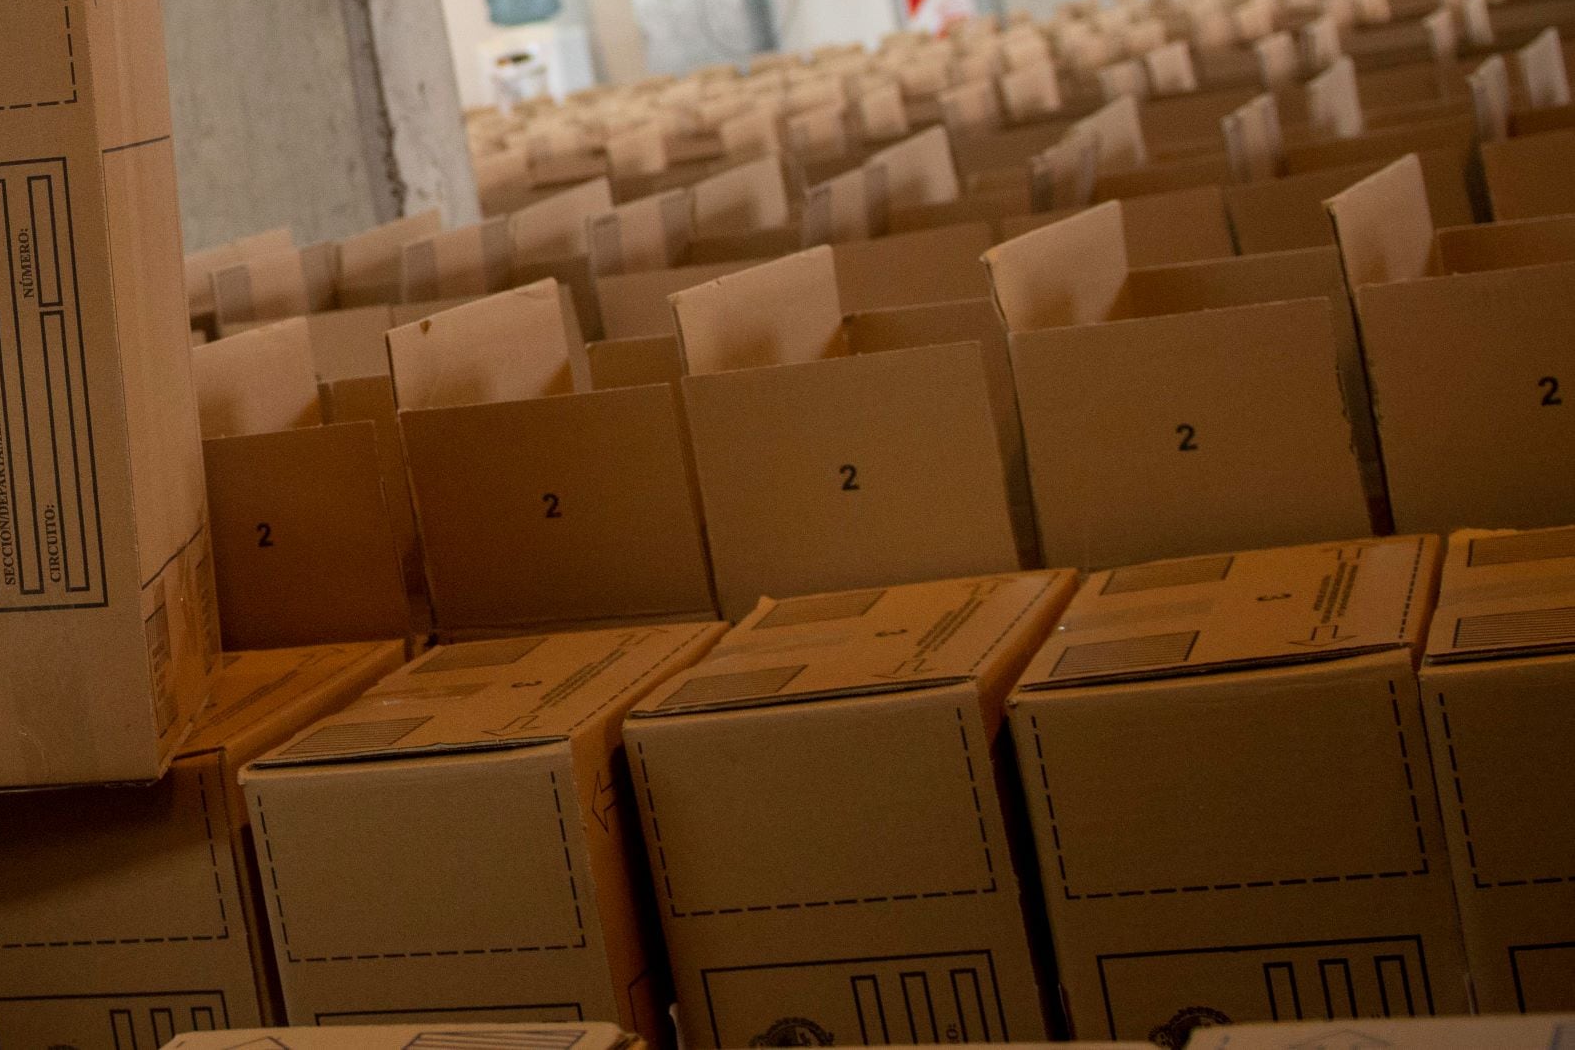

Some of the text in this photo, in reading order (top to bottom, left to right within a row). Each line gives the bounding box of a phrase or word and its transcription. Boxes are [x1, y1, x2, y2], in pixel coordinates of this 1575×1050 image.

[15, 227, 34, 299] NÚMERO:
[1539, 377, 1561, 406] 2
[1177, 425, 1197, 451] 2
[840, 465, 859, 490] 2
[543, 494, 561, 518] 2
[46, 503, 62, 583] CIRCUITO:
[257, 524, 273, 547] 2
